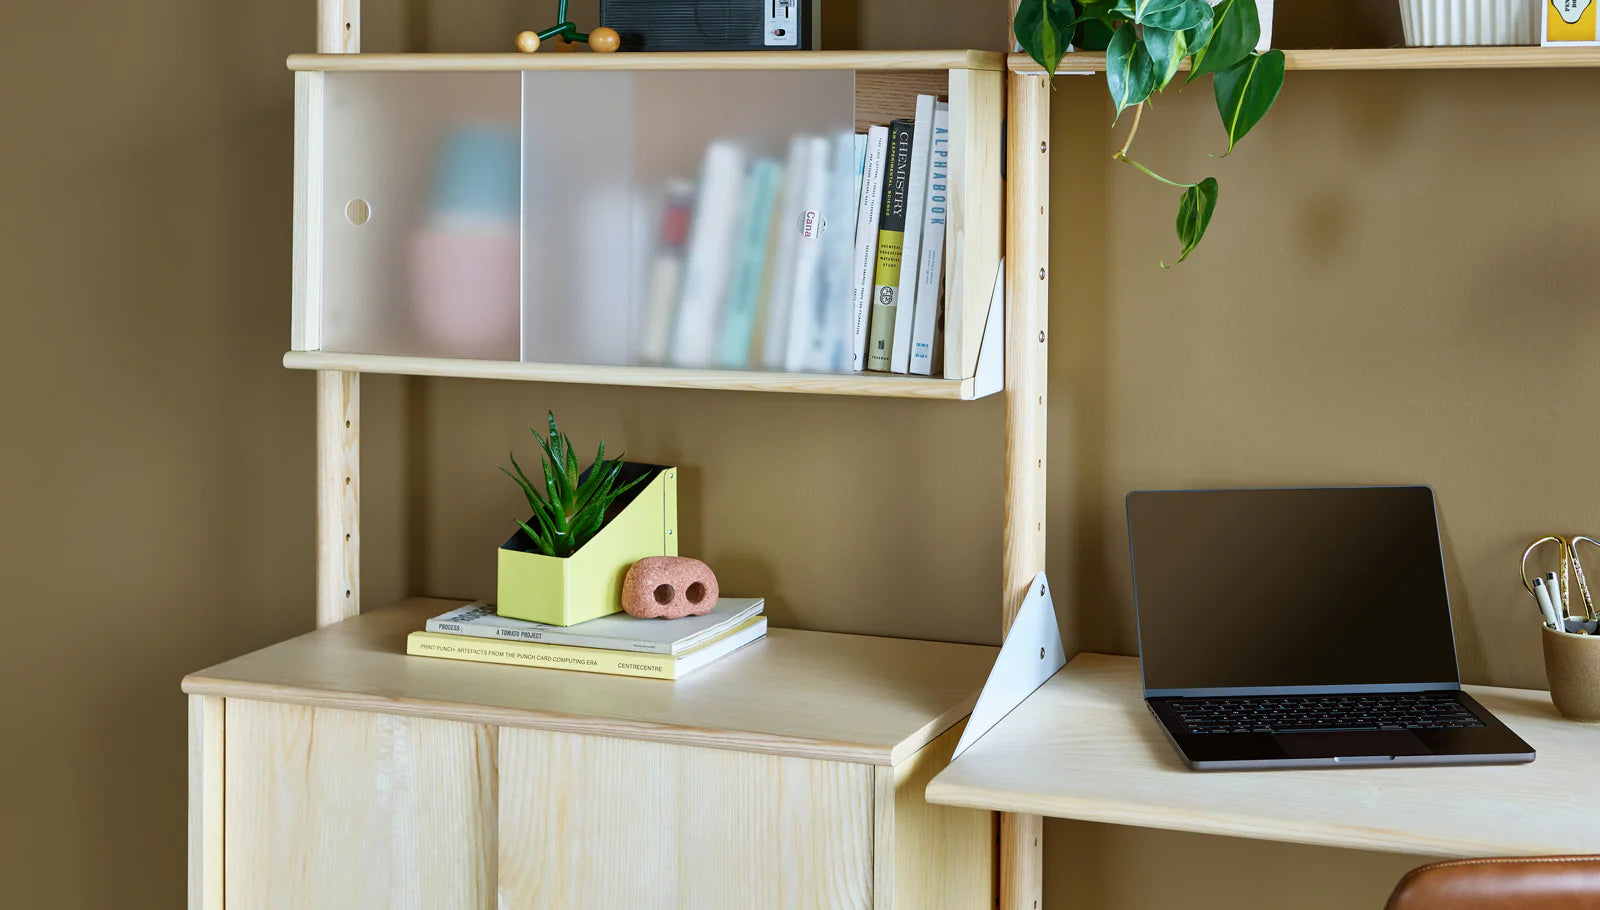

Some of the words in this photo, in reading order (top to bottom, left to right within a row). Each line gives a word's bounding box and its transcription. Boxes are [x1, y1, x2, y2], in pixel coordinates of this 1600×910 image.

[892, 130, 897, 139] AN
[888, 141, 896, 187] EXPERIMENTAL
[893, 131, 909, 217] CHEMISTRY
[931, 127, 948, 225] ALPHABOOK
[804, 211, 816, 238] Cana
[438, 623, 460, 632] PROCESS
[501, 629, 520, 638] TOMATO
[521, 631, 542, 639] PROJECT
[457, 647, 488, 656] ARTEFACTS
[552, 656, 586, 665] COMPUTING
[617, 662, 663, 672] CENTRECENTRE
